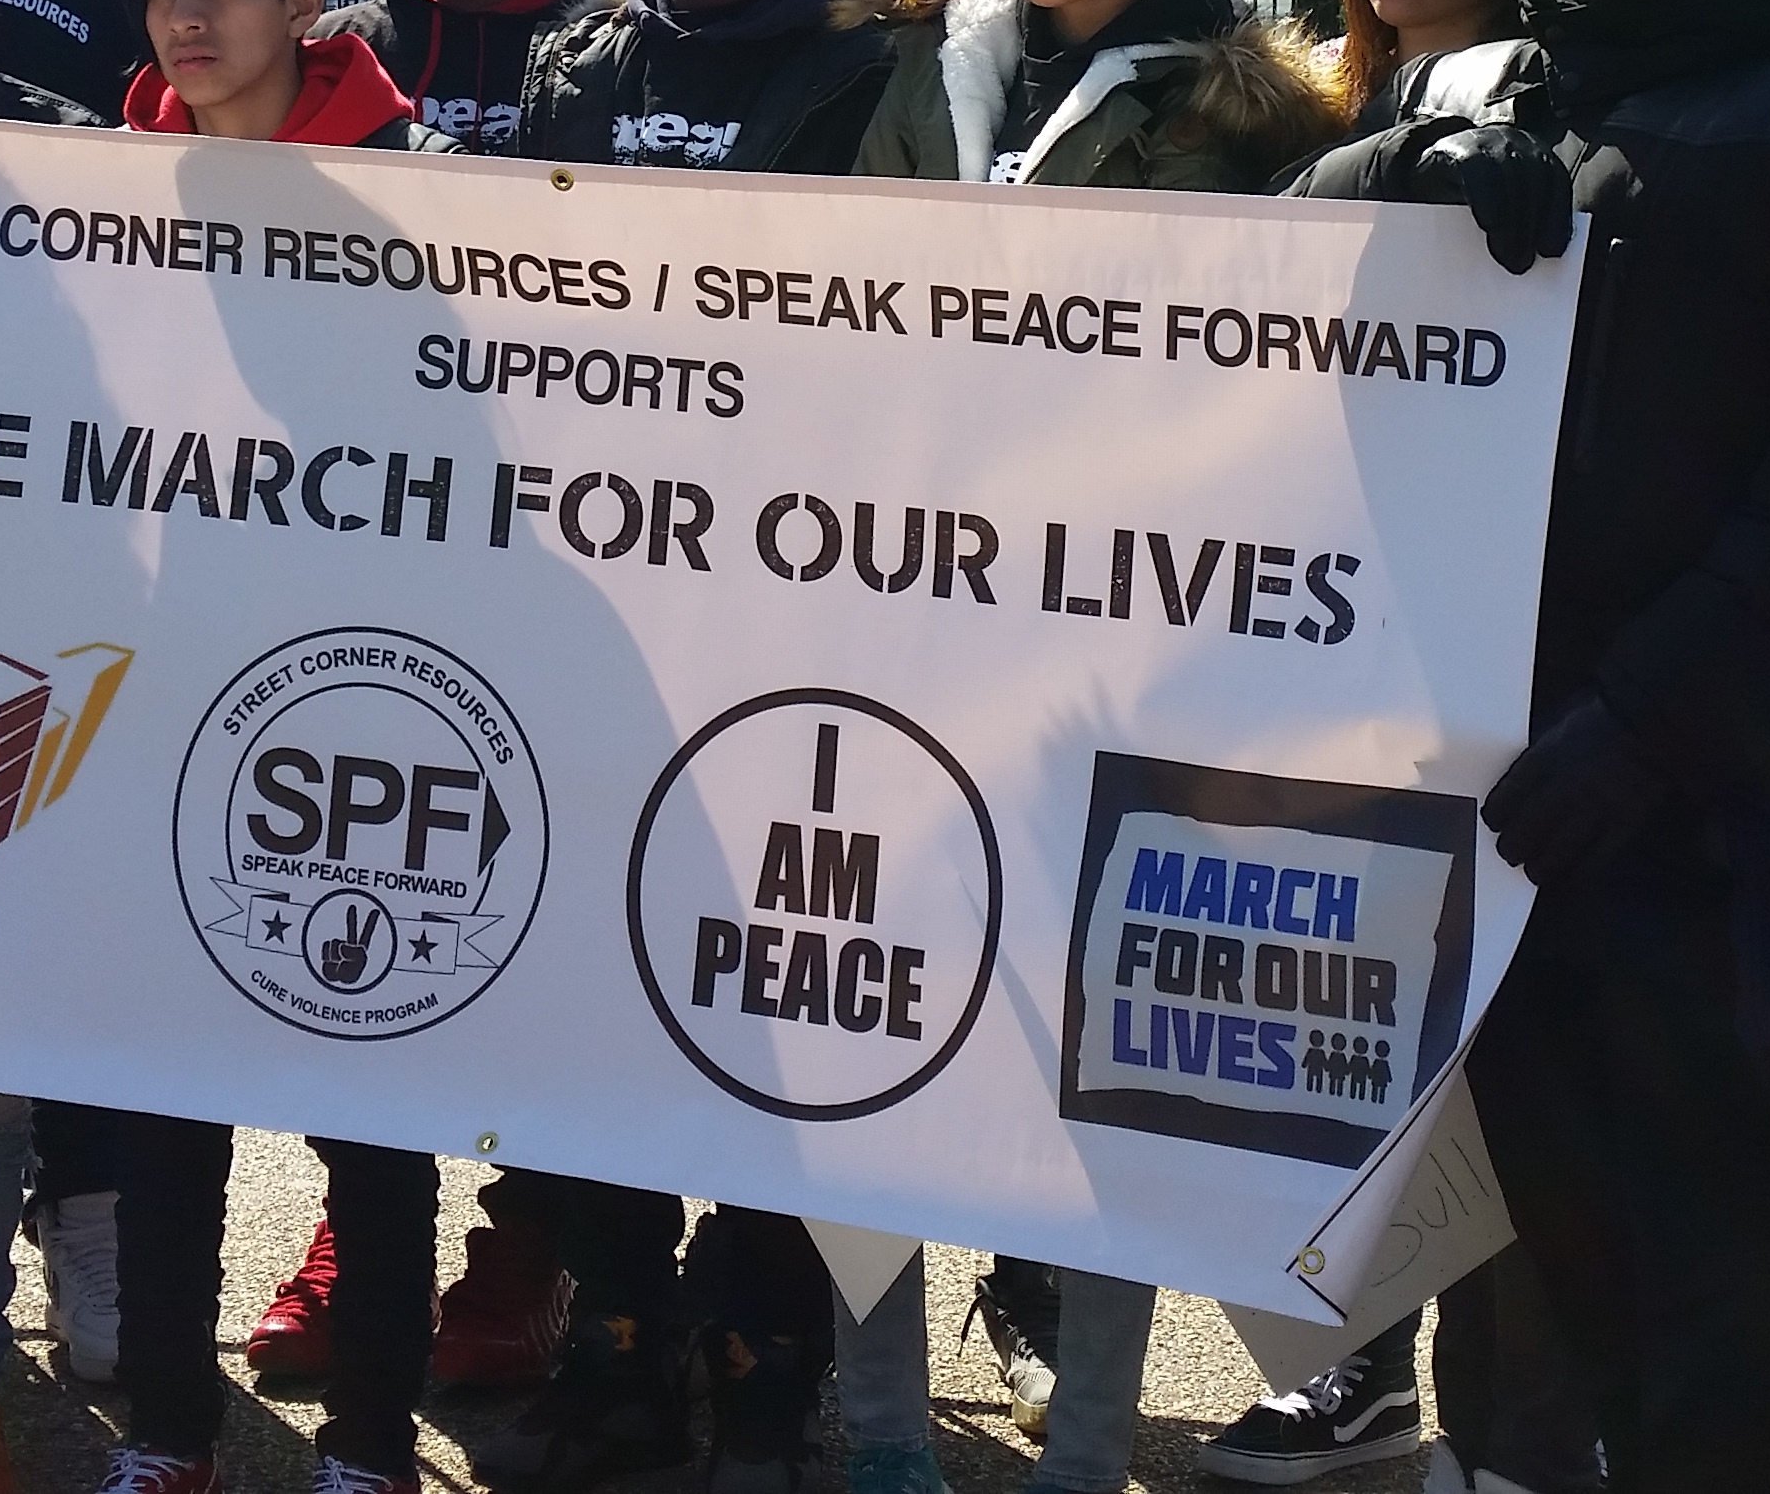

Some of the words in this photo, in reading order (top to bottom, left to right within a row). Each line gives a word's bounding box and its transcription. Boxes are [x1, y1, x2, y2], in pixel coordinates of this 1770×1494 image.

[264, 226, 631, 310] RESOURCES
[652, 263, 669, 312] /
[694, 266, 908, 335] SPEAK
[930, 284, 1142, 358] PEACE
[1165, 305, 1507, 388] FORWARD
[415, 334, 745, 418] SUPPORTS
[61, 419, 454, 544] MARCH
[489, 462, 715, 572] FOR
[755, 491, 1000, 606] OUR
[1040, 521, 1363, 646] LIVES
[223, 663, 295, 736] STREET
[299, 646, 397, 677] CORNER
[401, 655, 515, 766] RESOURCES
[245, 746, 480, 872] SPF
[811, 722, 839, 814] I
[240, 854, 305, 878] SPEAK
[307, 862, 369, 886] PEACE
[372, 870, 468, 899] FORWARD
[753, 821, 880, 925] AM
[1124, 848, 1359, 943] MARCH
[250, 969, 289, 1002] CURE
[288, 992, 362, 1024] VIOLENCE
[364, 992, 439, 1024] PROGRAM
[691, 915, 925, 1041] PEACE
[1115, 921, 1245, 1004] FOR
[1254, 945, 1397, 1027] OUR
[1111, 998, 1297, 1090] LIVES
